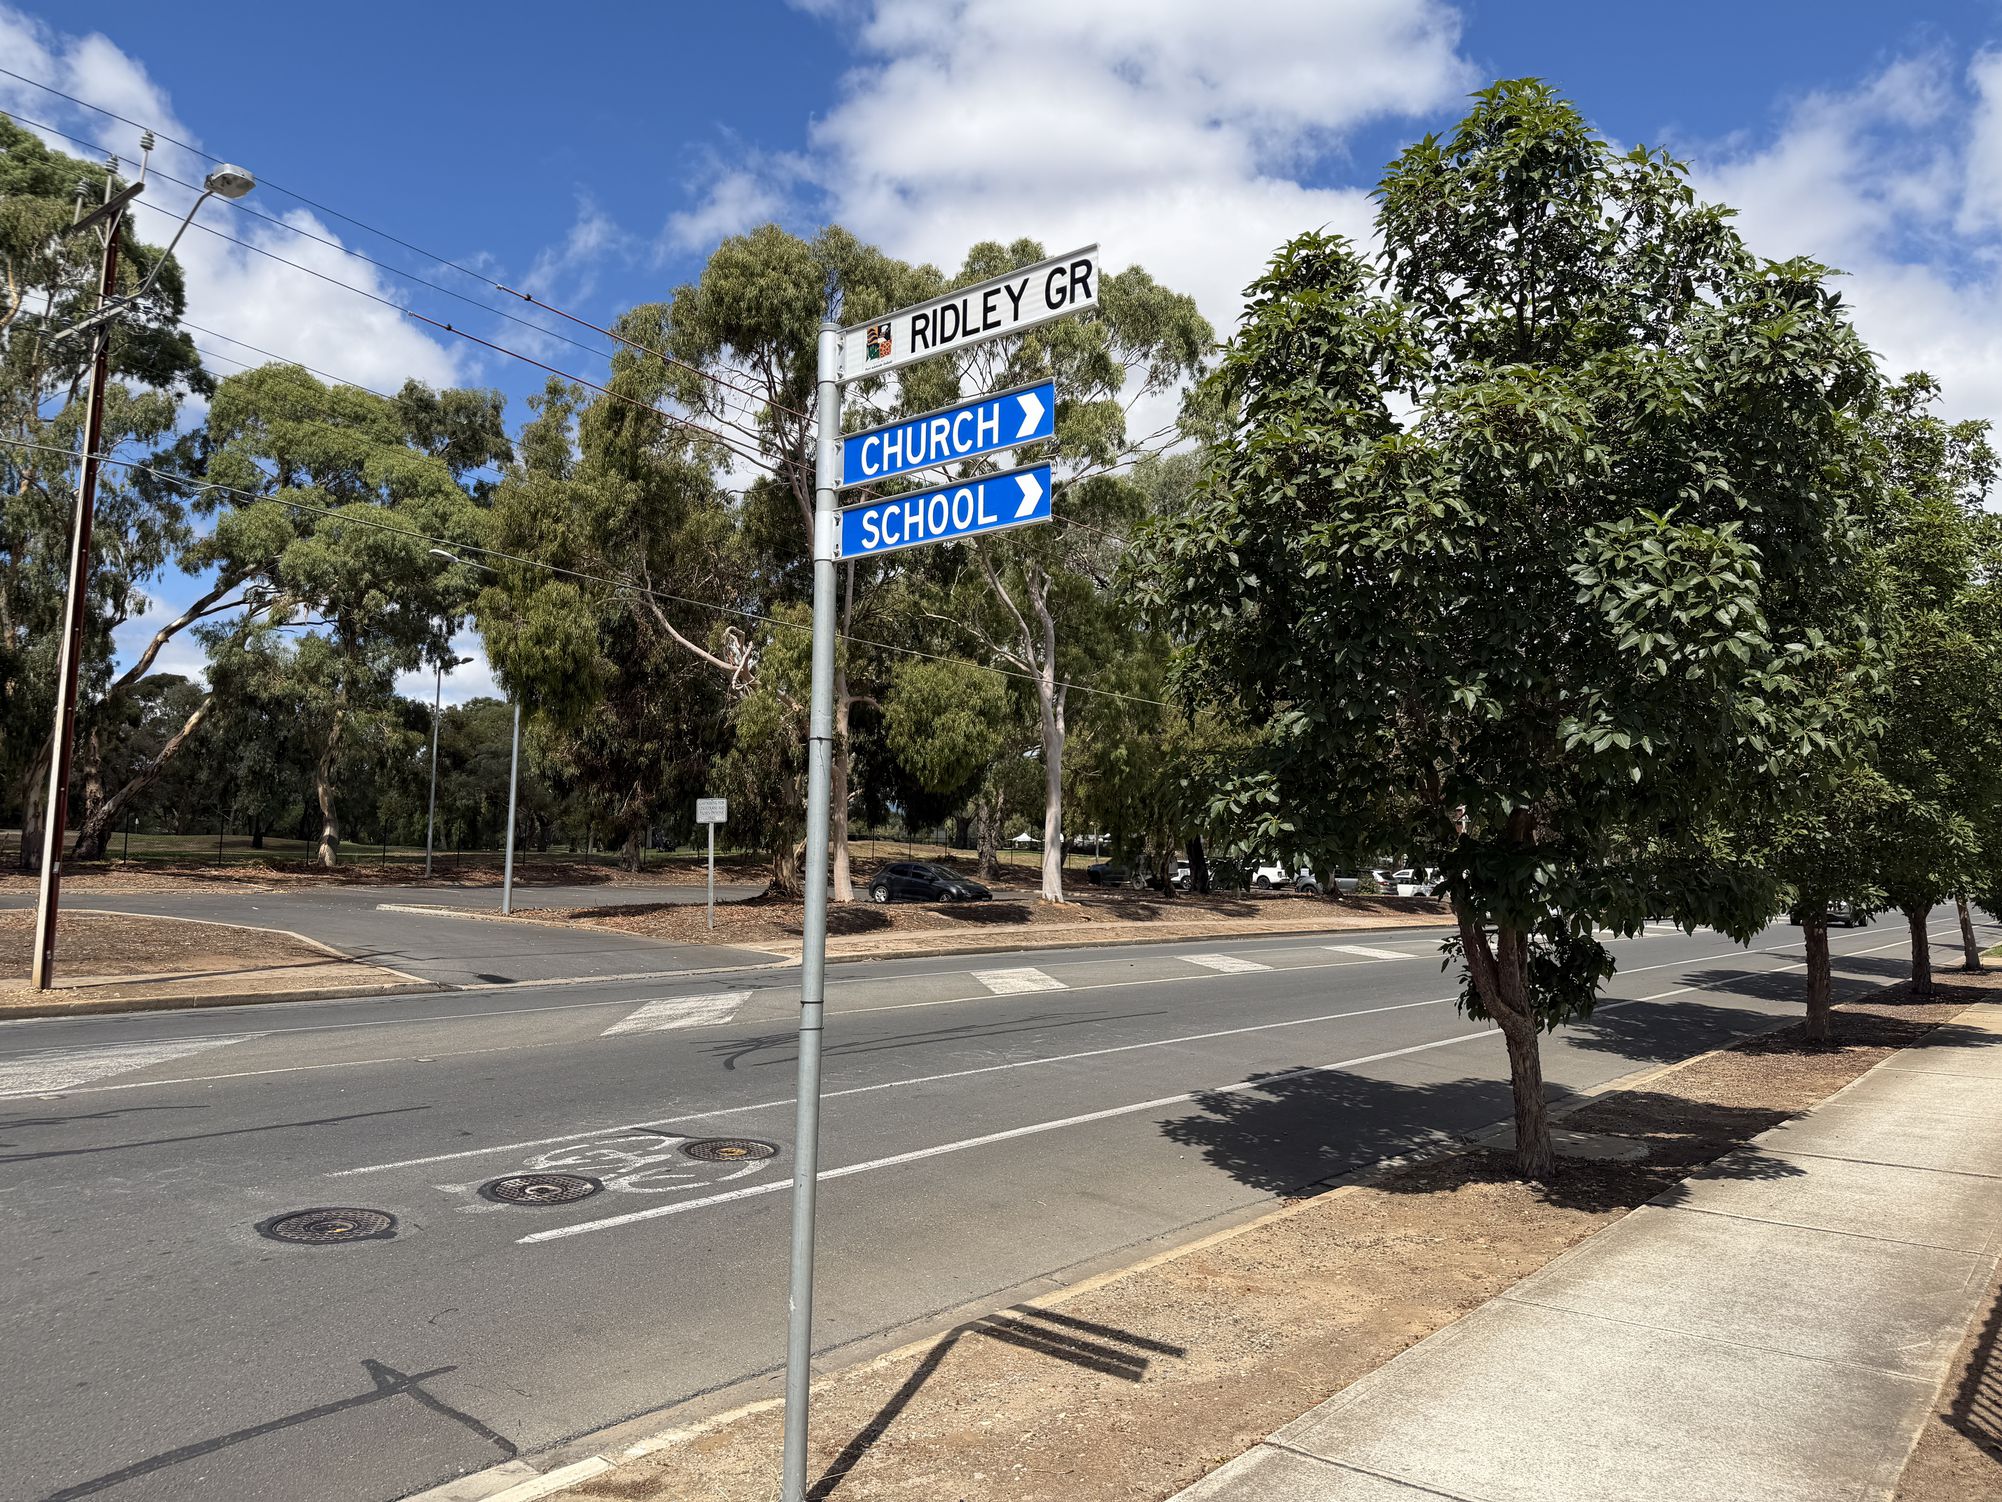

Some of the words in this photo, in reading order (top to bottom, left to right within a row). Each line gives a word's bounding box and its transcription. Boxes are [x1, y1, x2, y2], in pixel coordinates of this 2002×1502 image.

[911, 278, 1029, 353] RIDLEY
[1044, 259, 1093, 310] GR
[861, 403, 999, 476] CHURCH
[861, 484, 998, 549] SCHOOL
